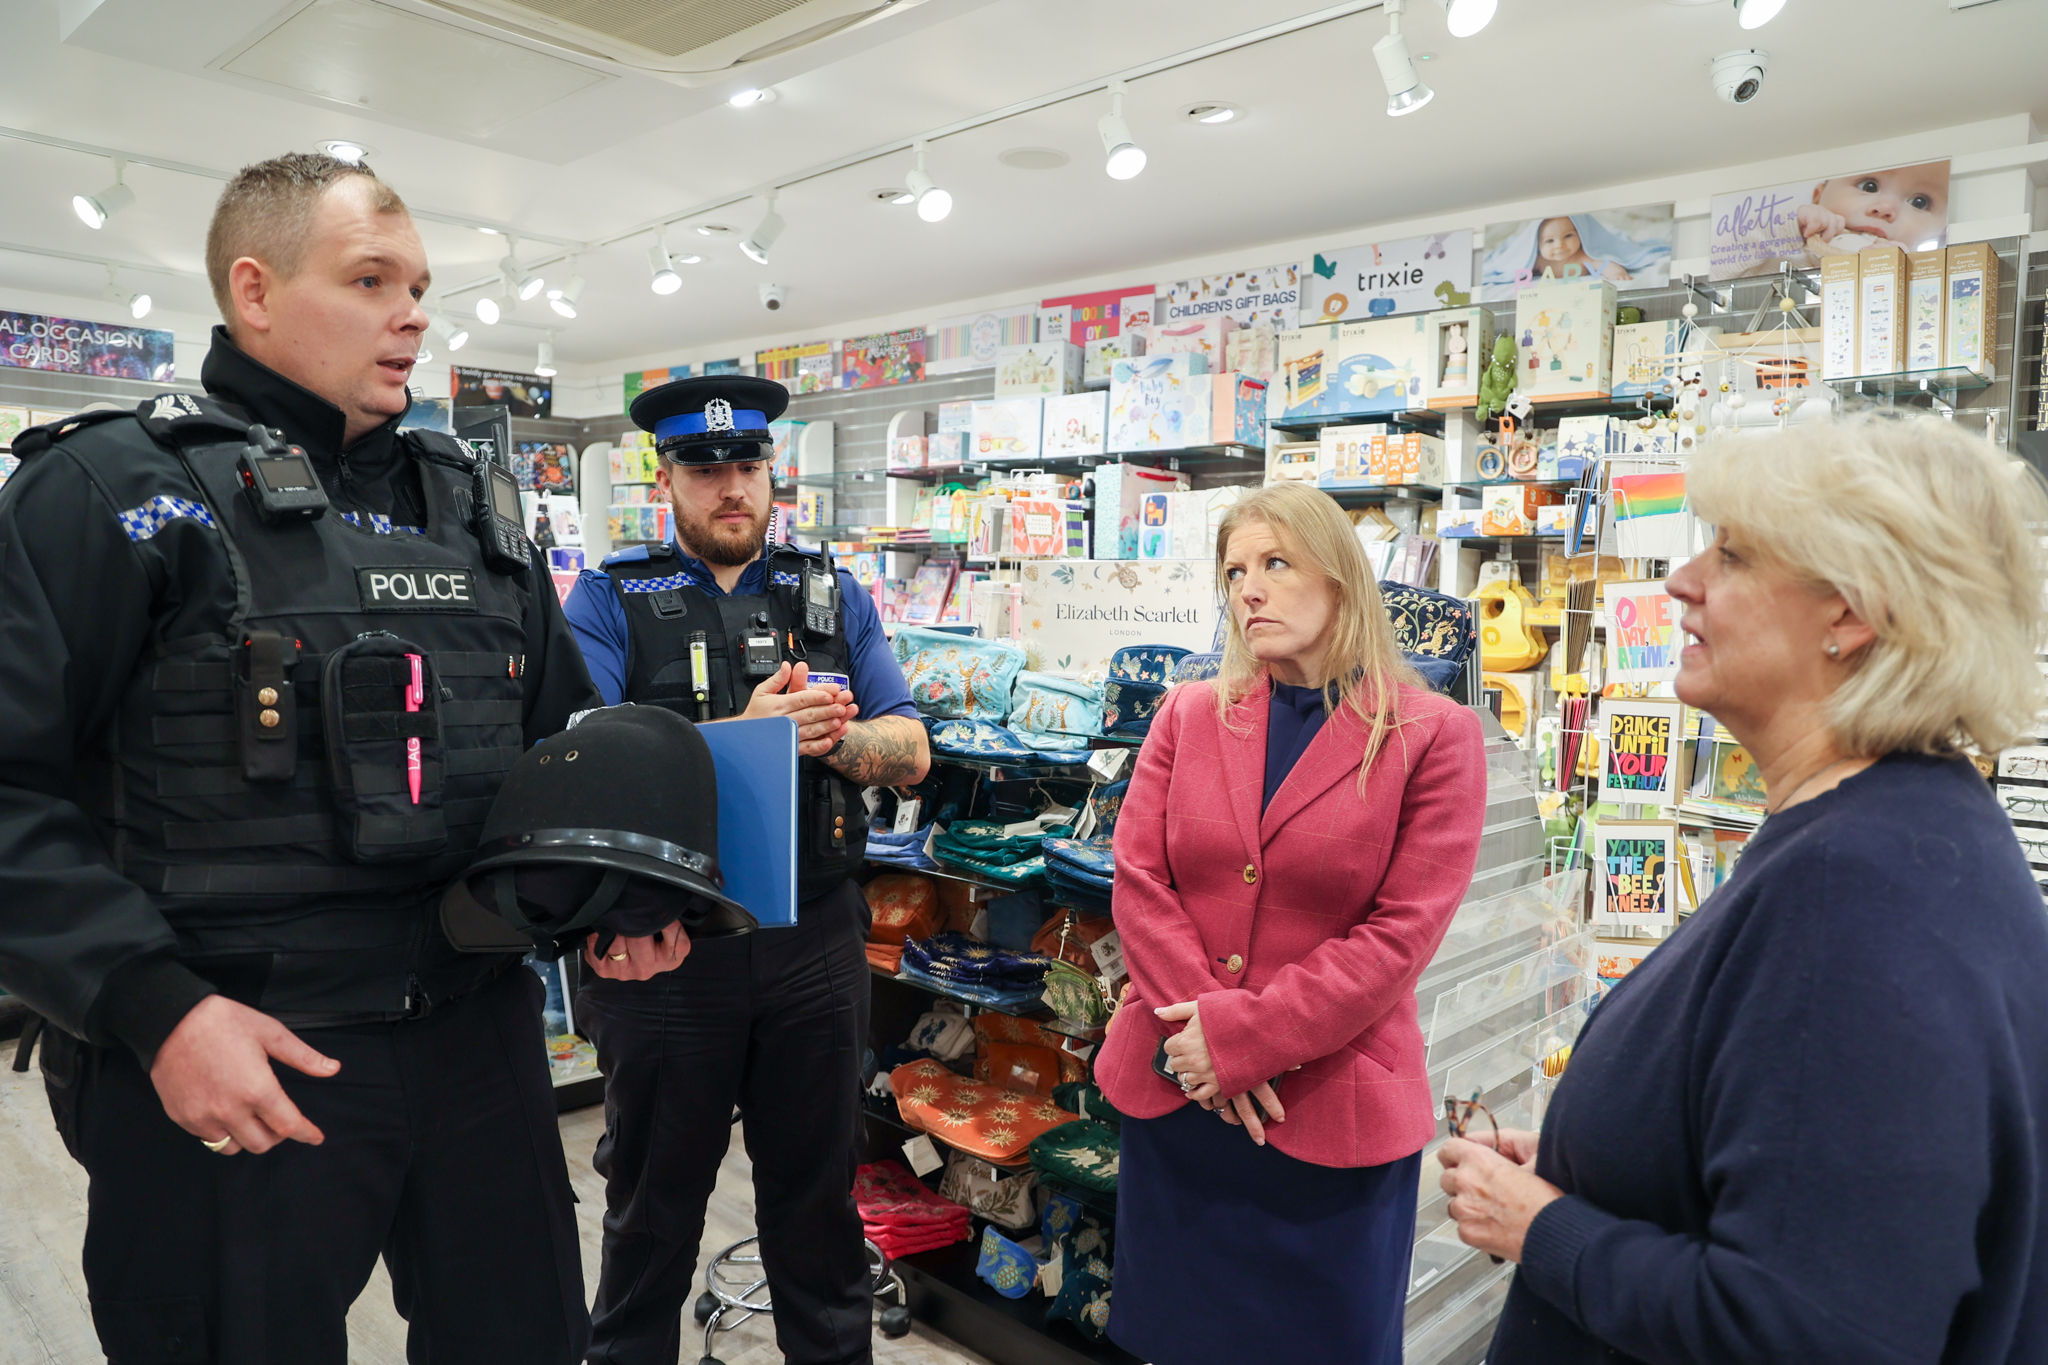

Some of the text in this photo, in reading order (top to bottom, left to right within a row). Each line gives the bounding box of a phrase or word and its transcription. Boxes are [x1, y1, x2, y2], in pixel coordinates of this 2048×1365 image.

[1717, 194, 1794, 241] albetta
[1710, 255, 1736, 266] world
[1738, 254, 1752, 262] for
[1754, 250, 1776, 260] little
[1711, 243, 1749, 254] Creating
[1358, 262, 1423, 291] trixie
[1072, 303, 1120, 322] WOODEN
[1170, 291, 1296, 318] CHILDREN'S GIFT BAGS
[30, 322, 143, 349] OCCASION
[845, 329, 923, 352] CHILDREN'S PUZZLES
[1082, 325, 1108, 340] TOYS
[1281, 332, 1302, 341] trixie
[1342, 326, 1365, 337] trixie
[1617, 327, 1637, 335] trixie
[9, 343, 80, 365] CARDS
[874, 345, 901, 358] GAMES
[493, 372, 514, 380] where
[370, 573, 470, 600] POLICE
[1056, 603, 1200, 624] Elizabeth Scarlett
[1616, 594, 1672, 628] ONE
[1617, 625, 1673, 647] DAY, AT
[1618, 646, 1630, 669] A
[1610, 752, 1667, 776] YOUR
[1608, 774, 1636, 788] FEET
[1607, 839, 1664, 857] YOU'RE
[1607, 856, 1644, 874] THE
[1618, 874, 1664, 895] BEES
